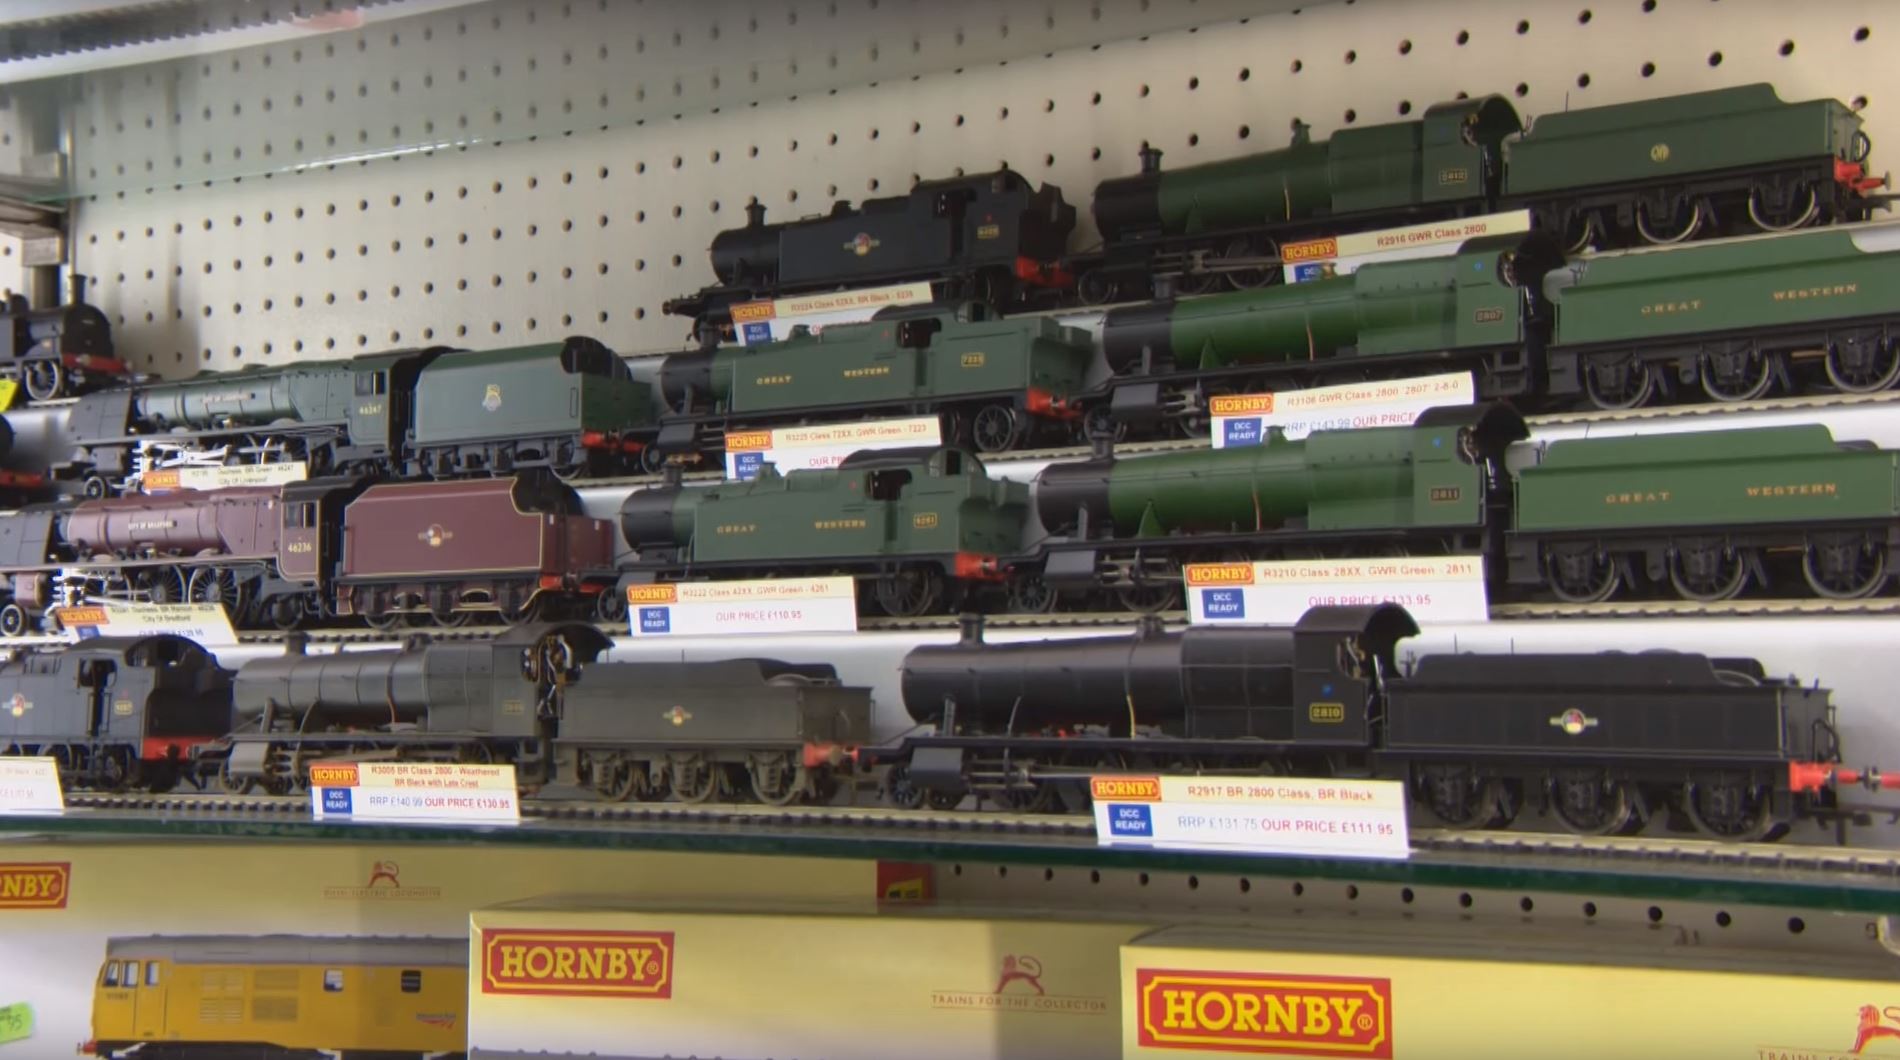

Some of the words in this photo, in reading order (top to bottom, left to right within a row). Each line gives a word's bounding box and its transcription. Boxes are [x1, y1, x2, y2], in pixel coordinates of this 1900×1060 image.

[1377, 233, 1406, 247] R2916
[1408, 230, 1433, 244] GWR
[1435, 226, 1462, 239] Class
[1464, 222, 1487, 236] 2800
[1285, 242, 1332, 258] HORNBY
[814, 300, 834, 310] Class
[1641, 300, 1702, 314] GREAT
[1773, 284, 1858, 300] WESTERN
[734, 304, 771, 319] HORNBY
[756, 375, 792, 385] GREAT
[844, 366, 890, 378] WESTERN
[1319, 393, 1343, 403] GWR
[1345, 390, 1372, 400] Class
[1376, 387, 1399, 398] 2800
[1434, 381, 1459, 392] 2-8-0
[1215, 398, 1268, 412] HORNBY
[1234, 422, 1252, 430] DCC
[1352, 415, 1378, 427] OUR
[1381, 412, 1416, 424] PRICE
[810, 430, 830, 440] Class
[856, 428, 876, 438] GWR
[878, 426, 901, 436] Green
[908, 424, 927, 433] 7223
[1228, 431, 1256, 440] READY
[728, 435, 769, 448] HORNBY
[742, 456, 756, 464] DCC
[808, 456, 830, 466] OUR
[738, 464, 760, 473] READY
[1432, 489, 1459, 500] 2811
[1606, 492, 1671, 504] GREAT
[1746, 484, 1837, 496] WESTERN
[716, 524, 756, 534] GREAT
[815, 519, 867, 529] WESTERN
[288, 543, 312, 553] 46236
[1190, 566, 1249, 582] HORNBY
[1263, 567, 1297, 578] R3210
[1300, 566, 1329, 577] Class
[1368, 566, 1397, 577] GWR
[1400, 564, 1435, 576] Green
[1446, 564, 1472, 574] 2811
[631, 587, 673, 600] HORNBY
[709, 588, 730, 597] Class
[756, 586, 777, 596] GWR
[779, 585, 804, 594] Green
[1212, 592, 1233, 602] DCC
[1308, 596, 1336, 607] OUR
[1340, 595, 1378, 606] PRICE
[1208, 603, 1239, 613] READY
[716, 612, 738, 622] OUR
[739, 612, 766, 621] PRICE
[644, 620, 666, 628] READY
[313, 769, 355, 782] HORNBY
[397, 766, 409, 775] BR
[411, 766, 432, 775] Class
[434, 766, 452, 776] 2800
[459, 766, 500, 776] Weathered
[394, 778, 406, 786] BR
[407, 778, 426, 787] Black
[428, 778, 442, 788] with
[444, 779, 459, 788] Late
[460, 780, 479, 788] Crest
[1096, 781, 1154, 797] HORNBY
[329, 791, 344, 800] DCC
[1188, 786, 1222, 797] R2917
[1226, 786, 1244, 798] BR
[1248, 788, 1274, 798] 2800
[1318, 788, 1336, 800] BR
[1340, 789, 1374, 801] Black
[326, 800, 349, 809] READY
[369, 796, 388, 806] RRP
[425, 798, 446, 807] OUR
[448, 798, 475, 808] PRICE
[476, 799, 510, 810] £130.95
[1120, 808, 1140, 818] DCC
[1115, 820, 1146, 831] READY
[1178, 816, 1206, 828] RRP
[1209, 816, 1258, 830] £131.75
[1262, 819, 1291, 832] OUR
[1296, 820, 1336, 833] PRICE
[1342, 822, 1394, 836] £111.95
[0, 875, 54, 898] NBY
[500, 945, 650, 981] HORNBY
[932, 994, 974, 1006] TRAINS
[980, 996, 1001, 1006] FOR
[1008, 997, 1028, 1008] THE
[1034, 998, 1107, 1011] COLLECTOR
[1162, 989, 1362, 1038] HORNBY
